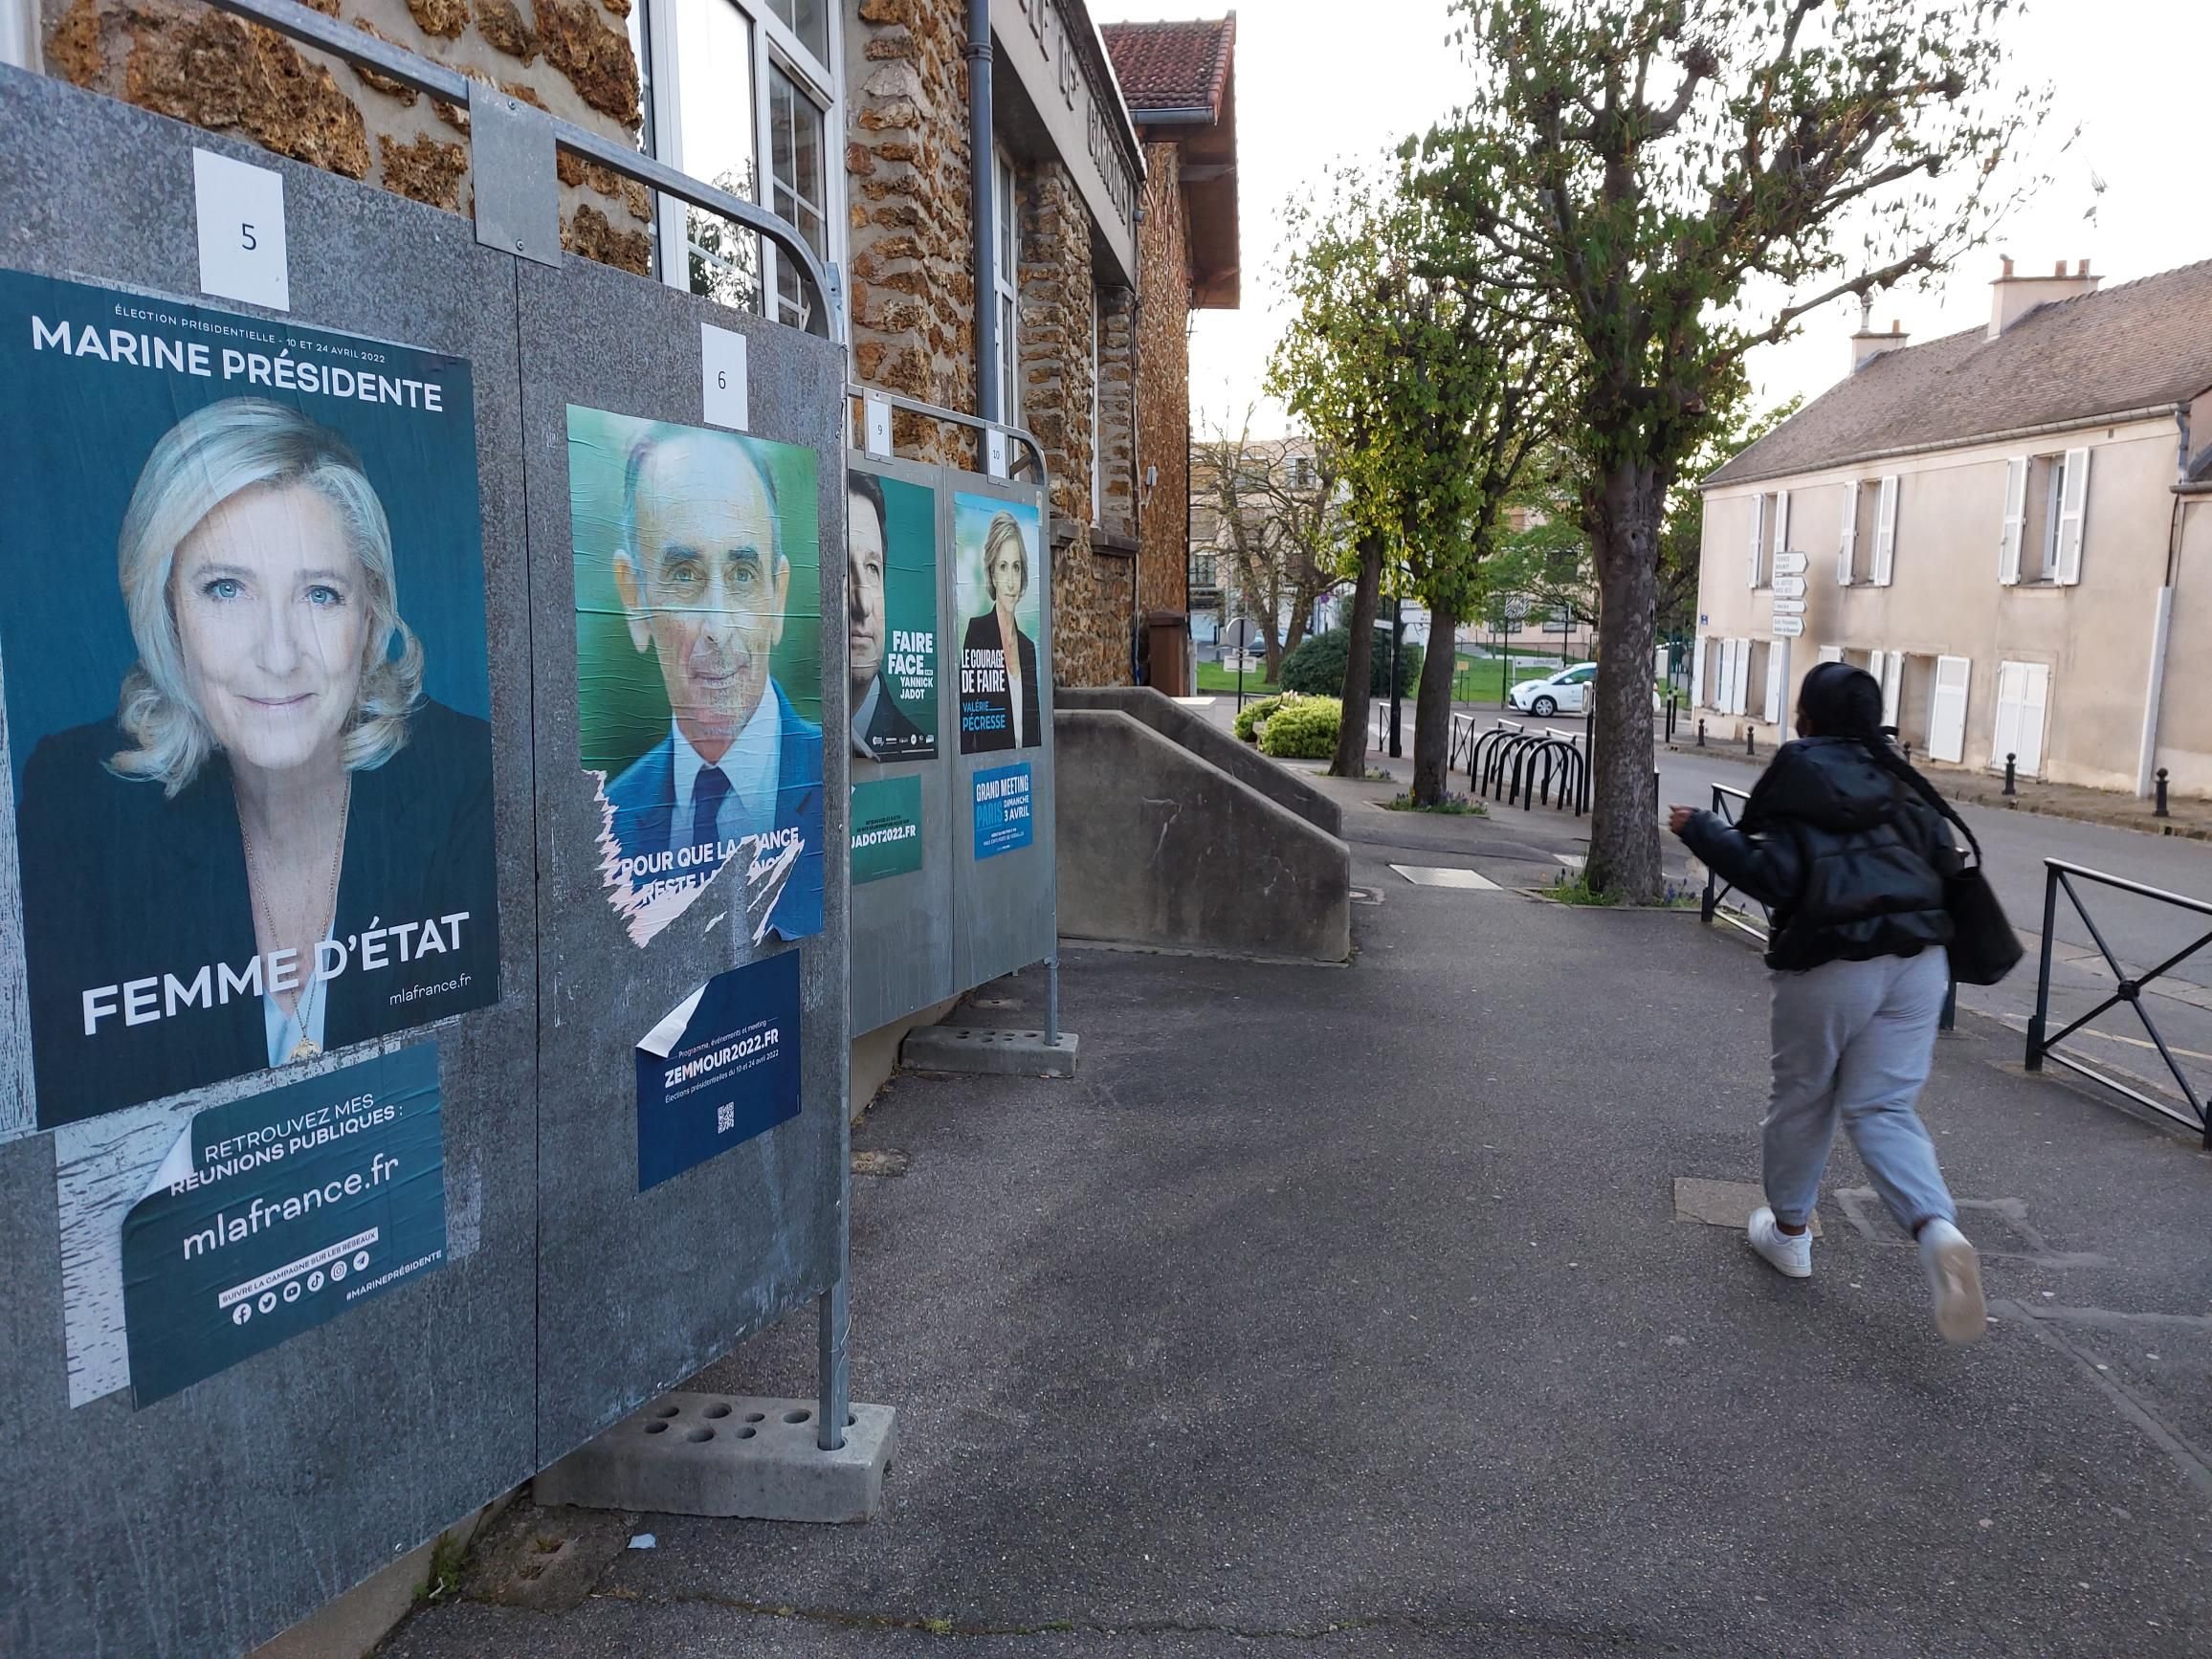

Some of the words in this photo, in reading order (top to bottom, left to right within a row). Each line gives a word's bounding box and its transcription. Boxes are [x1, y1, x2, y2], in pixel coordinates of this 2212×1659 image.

[242, 223, 256, 250] 5
[115, 302, 177, 325] ÉLECTION
[286, 338, 297, 347] 10
[299, 341, 313, 350] ET
[316, 343, 328, 353] 24
[331, 346, 359, 359] AVRIL
[361, 352, 386, 363] 2022
[32, 315, 211, 377] MARINE
[222, 348, 443, 412] PRÉSIDENTE
[718, 370, 726, 389] 6
[877, 425, 883, 435] 9
[992, 449, 1000, 460] 10
[893, 630, 934, 653] FAIRE
[888, 653, 924, 675] FACE
[962, 649, 970, 669] LE
[970, 649, 1005, 669] COURAGE
[899, 675, 934, 688] YANNICK
[899, 688, 925, 700] JADOT
[962, 670, 975, 694] DE
[977, 669, 1006, 694] FAIRE
[962, 699, 989, 713] VALÉRIE
[962, 713, 1006, 732] PÉCRESSE
[976, 780, 1000, 803] GRAND
[1000, 774, 1029, 797] MEETING
[1003, 794, 1029, 808] DIMANCHE
[977, 802, 1003, 828] PARIS
[1004, 809, 1008, 822] 3
[1009, 806, 1029, 821] AVRIL
[620, 851, 674, 876] POUR
[677, 842, 714, 867] QUE
[717, 839, 736, 860] LA
[82, 947, 299, 1036] FEMME
[314, 911, 470, 982] D'ÉTAT
[389, 973, 472, 1006] mlafrance.fr
[664, 1028, 779, 1089] ZEMMOUR2022.FR
[728, 1068, 736, 1076] du
[748, 1059, 755, 1068] 24
[755, 1055, 766, 1065] avril
[766, 1049, 779, 1060] 2022
[205, 1107, 330, 1163] RETROUVEZ
[335, 1094, 374, 1119] MES
[290, 1105, 395, 1155] PUBLIQUES
[183, 1153, 399, 1260] mlafrance.fr
[222, 1284, 253, 1302] SUIVRE
[254, 1280, 264, 1289] LA
[266, 1260, 309, 1284] CAMPAGNE
[311, 1253, 326, 1264] SUR
[327, 1248, 342, 1257] LES
[343, 1231, 375, 1251] RÉSEAUX
[346, 1250, 442, 1301] #MARINEPRÉSIDENTE
